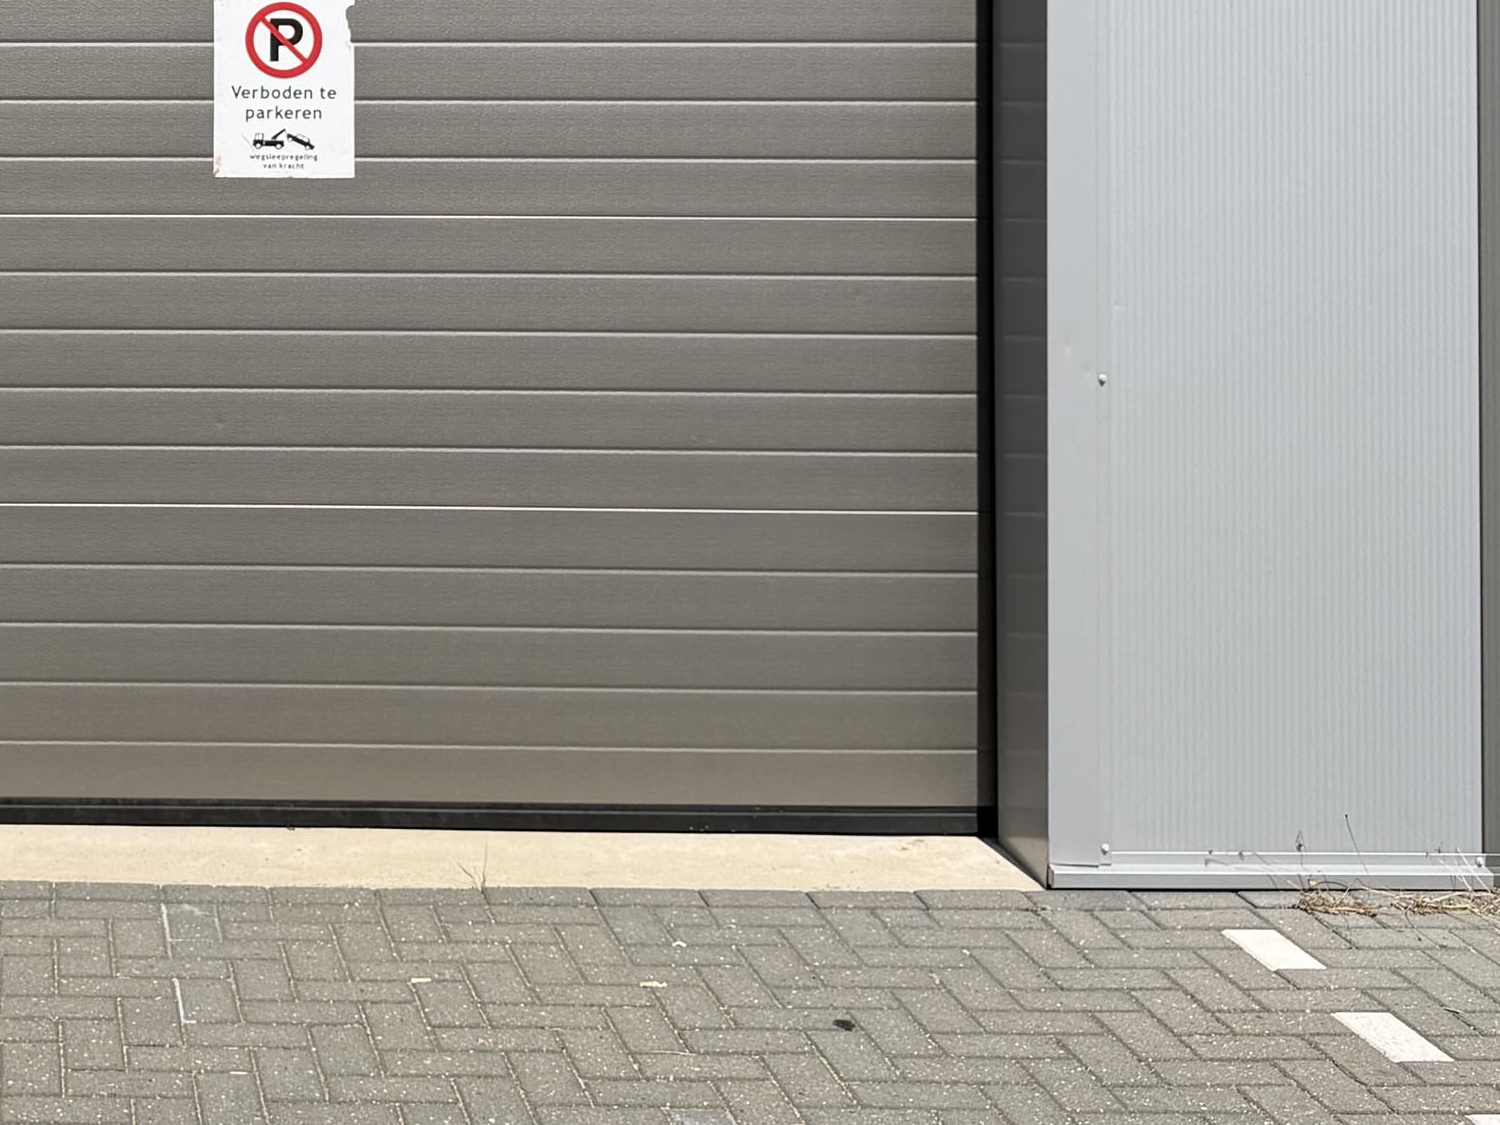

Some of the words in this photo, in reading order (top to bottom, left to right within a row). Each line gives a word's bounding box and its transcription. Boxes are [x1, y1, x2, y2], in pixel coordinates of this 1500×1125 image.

[270, 18, 304, 62] P
[231, 85, 313, 100] Verboden
[319, 86, 337, 100] te
[245, 106, 322, 122] parkeren
[249, 153, 318, 162] wegsleepregeling
